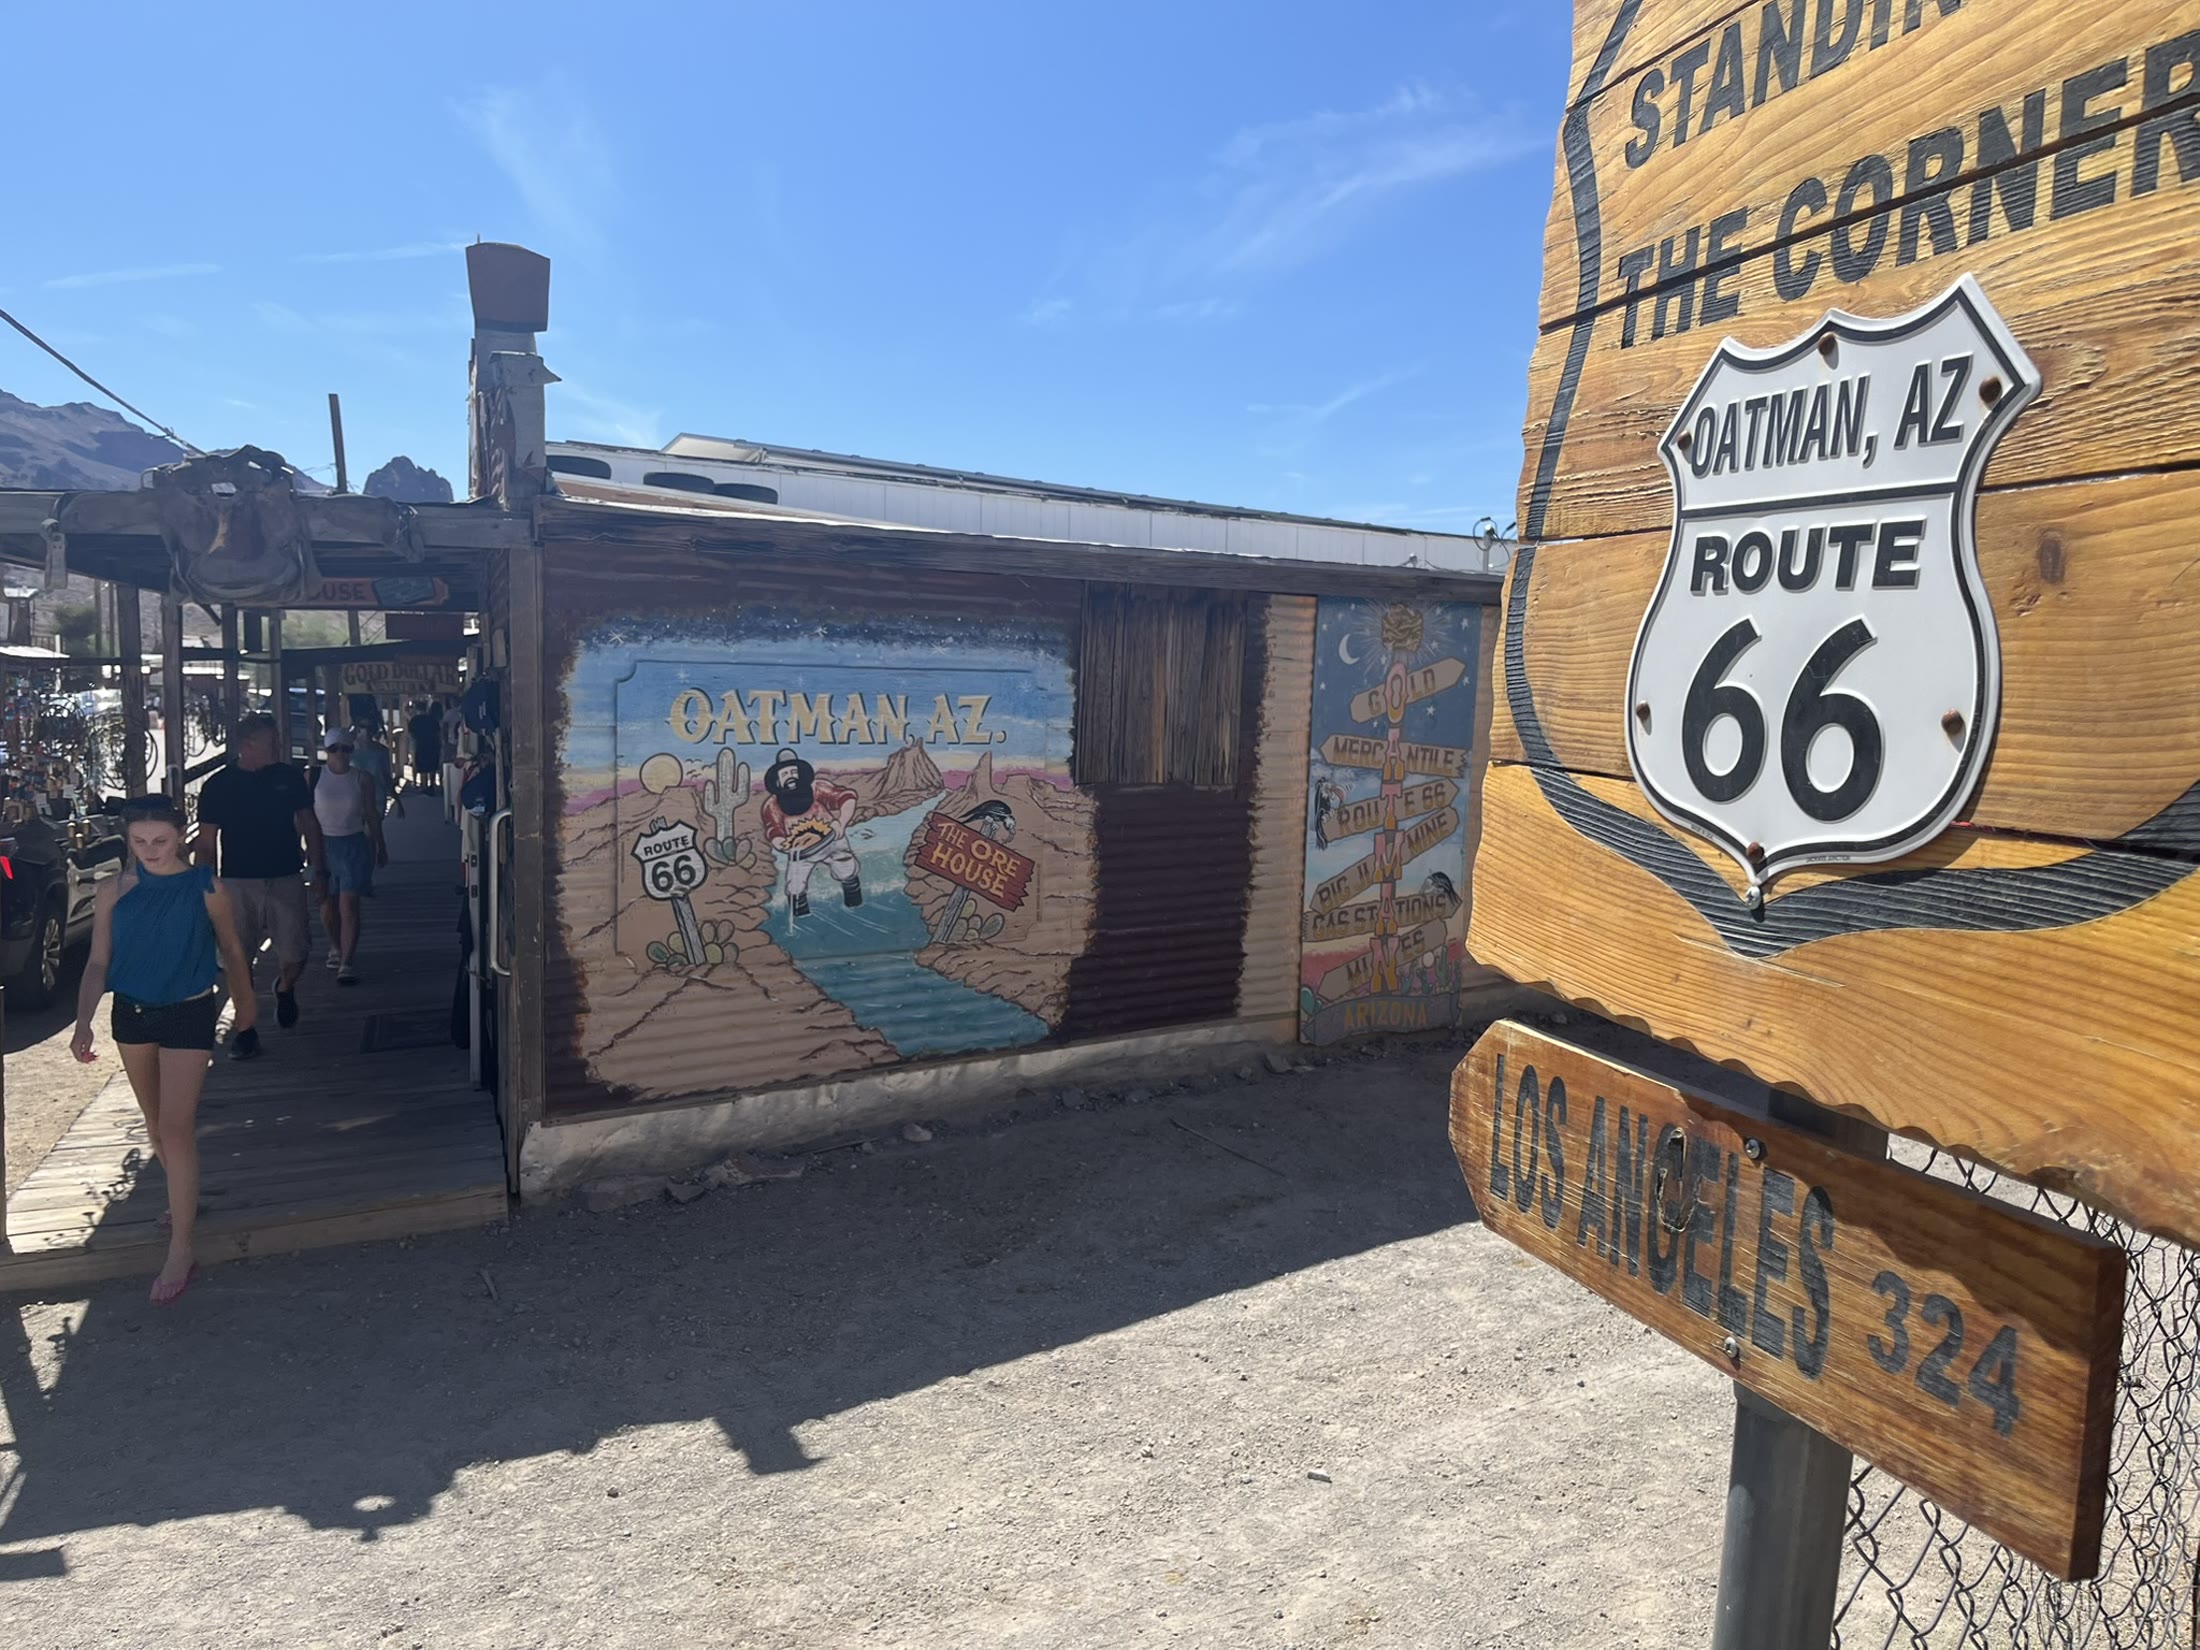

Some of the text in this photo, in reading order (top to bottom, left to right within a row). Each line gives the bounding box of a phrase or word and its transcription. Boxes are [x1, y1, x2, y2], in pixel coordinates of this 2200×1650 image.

[1618, 28, 2200, 348] THE CORNER
[1689, 352, 1974, 480] OATMAN, AZ
[1689, 515, 1928, 595] ROUTE
[343, 663, 389, 686] GOLD
[1367, 667, 1436, 721] GOLD
[665, 688, 1007, 746] OATMAN, AZ.
[1680, 616, 1885, 823] 66
[1332, 736, 1456, 778] MERCANTILE
[1337, 782, 1447, 835] ROUTE 66
[643, 835, 690, 857] ROUTE
[651, 854, 696, 892] 66
[929, 842, 1009, 898] HOUSE
[937, 822, 1021, 878] THE ORE
[1316, 875, 1350, 912] BIG
[1405, 812, 1449, 856] MINE
[1312, 890, 1447, 939] GAS STATIONS
[1346, 930, 1425, 989] MINES
[1343, 1000, 1429, 1032] ARIZONA
[1489, 1053, 2022, 1439] LOS ANGELES 324
